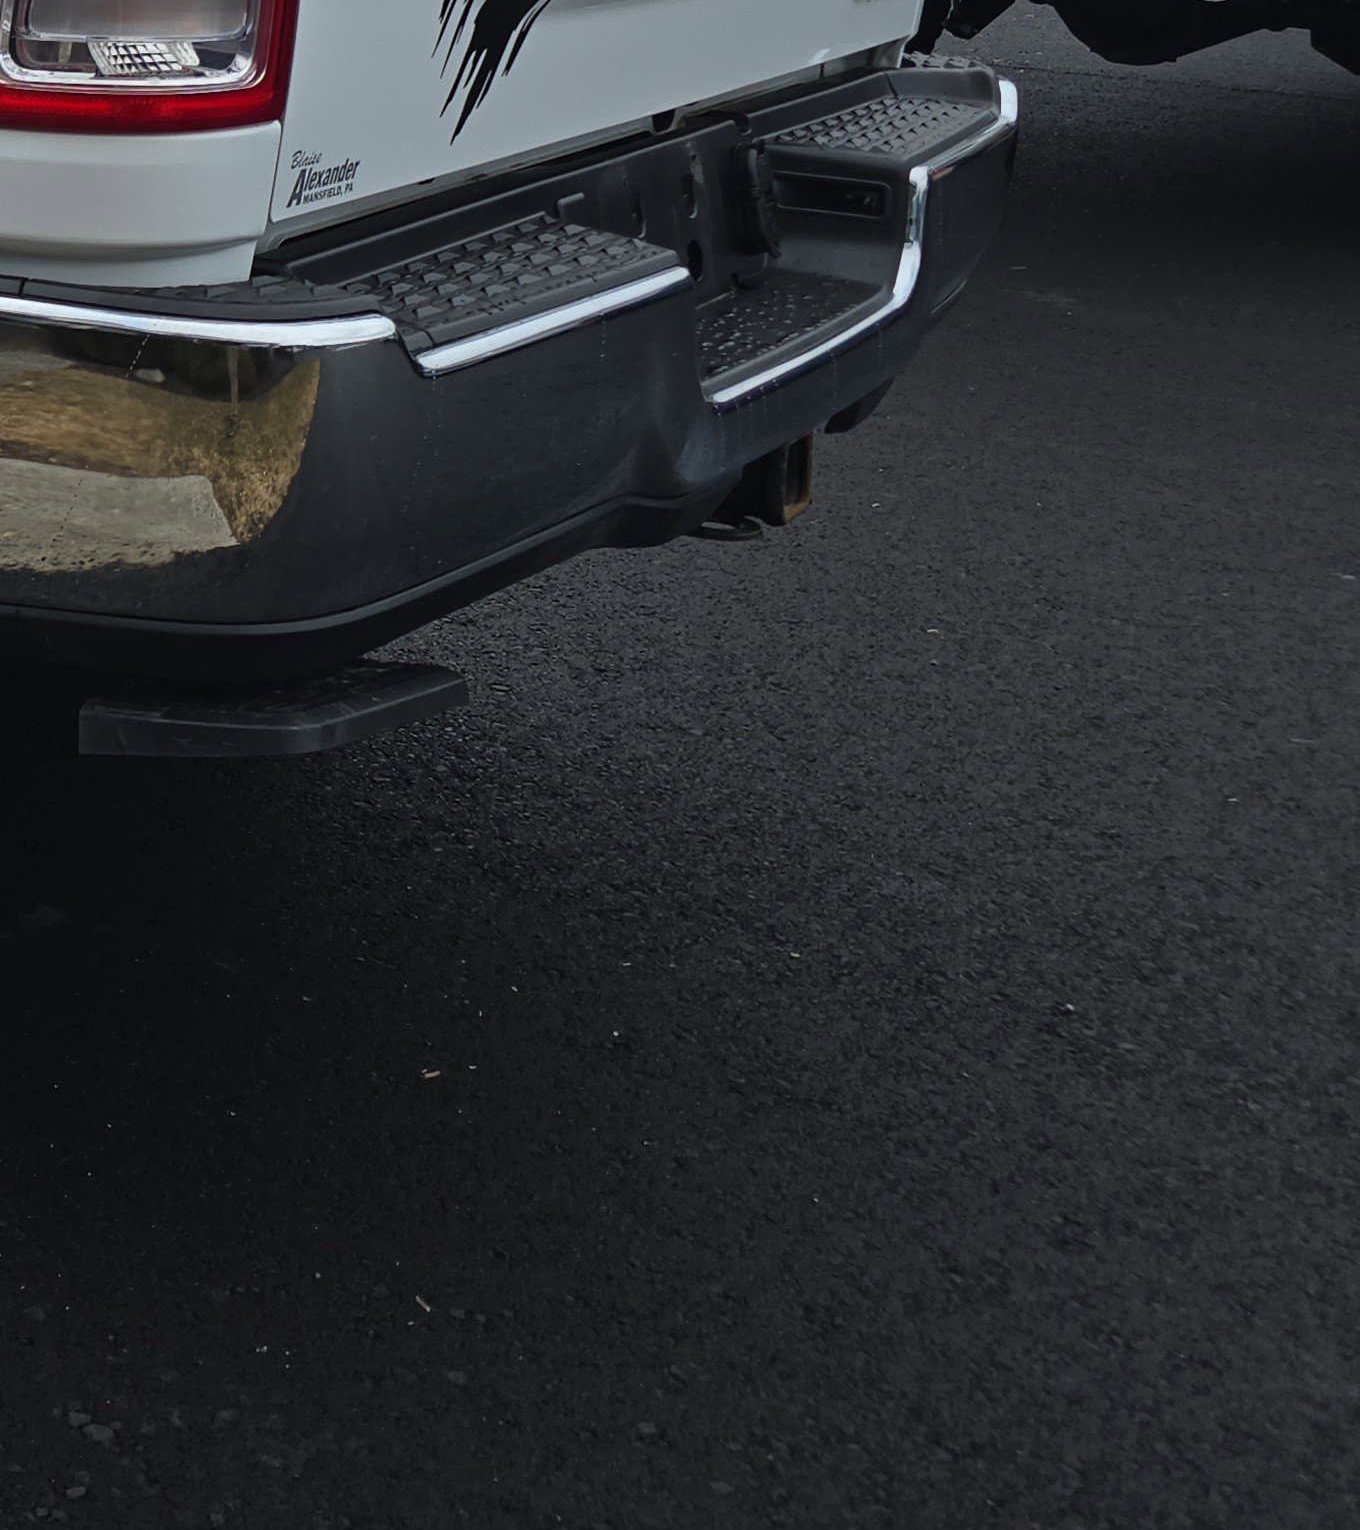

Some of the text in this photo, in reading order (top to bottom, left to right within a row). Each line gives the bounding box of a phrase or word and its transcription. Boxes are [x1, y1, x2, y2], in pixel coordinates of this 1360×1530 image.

[290, 150, 323, 169] Blaise
[285, 158, 361, 209] Alexander
[302, 182, 354, 204] MANSFIELD, PA
